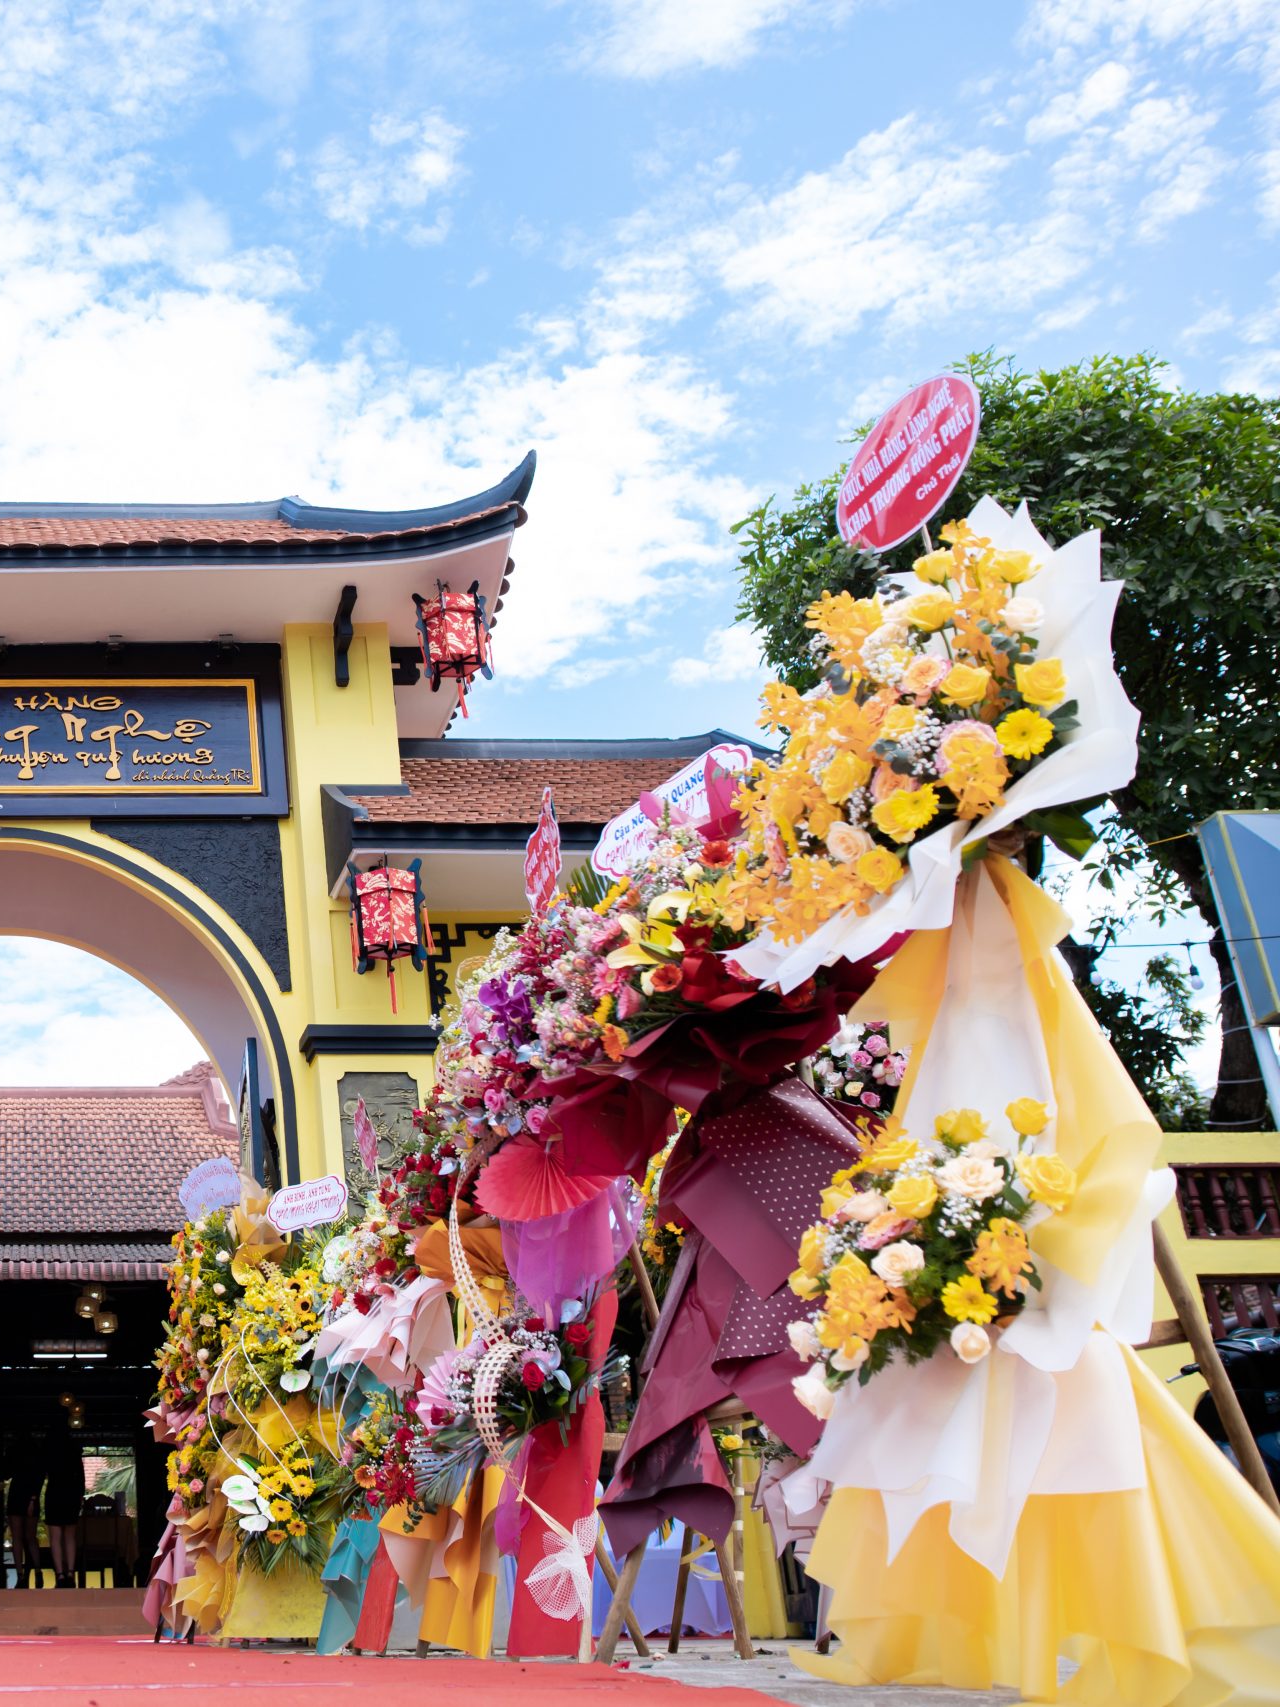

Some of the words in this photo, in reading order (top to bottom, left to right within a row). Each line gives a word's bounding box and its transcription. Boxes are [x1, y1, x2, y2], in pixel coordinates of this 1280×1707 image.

[842, 469, 864, 506] CHÚC
[861, 448, 883, 489] NHÀ
[879, 434, 907, 467] HÀNG
[903, 411, 929, 445] LÀNG
[927, 379, 955, 425] NGHỆ
[937, 453, 962, 480] Thái
[844, 503, 872, 538] KHAI
[869, 464, 911, 516] TRƯƠNG
[910, 434, 942, 474] HỒNG
[939, 402, 972, 447] PHÁT
[14, 692, 124, 712] HÀNG
[60, 709, 212, 780] Nghệ
[75, 751, 124, 768] quê
[131, 748, 215, 766] hương
[132, 769, 150, 781] chi
[152, 769, 190, 781] nhánh
[614, 825, 631, 841] Cậu
[671, 769, 705, 803] QUANG
